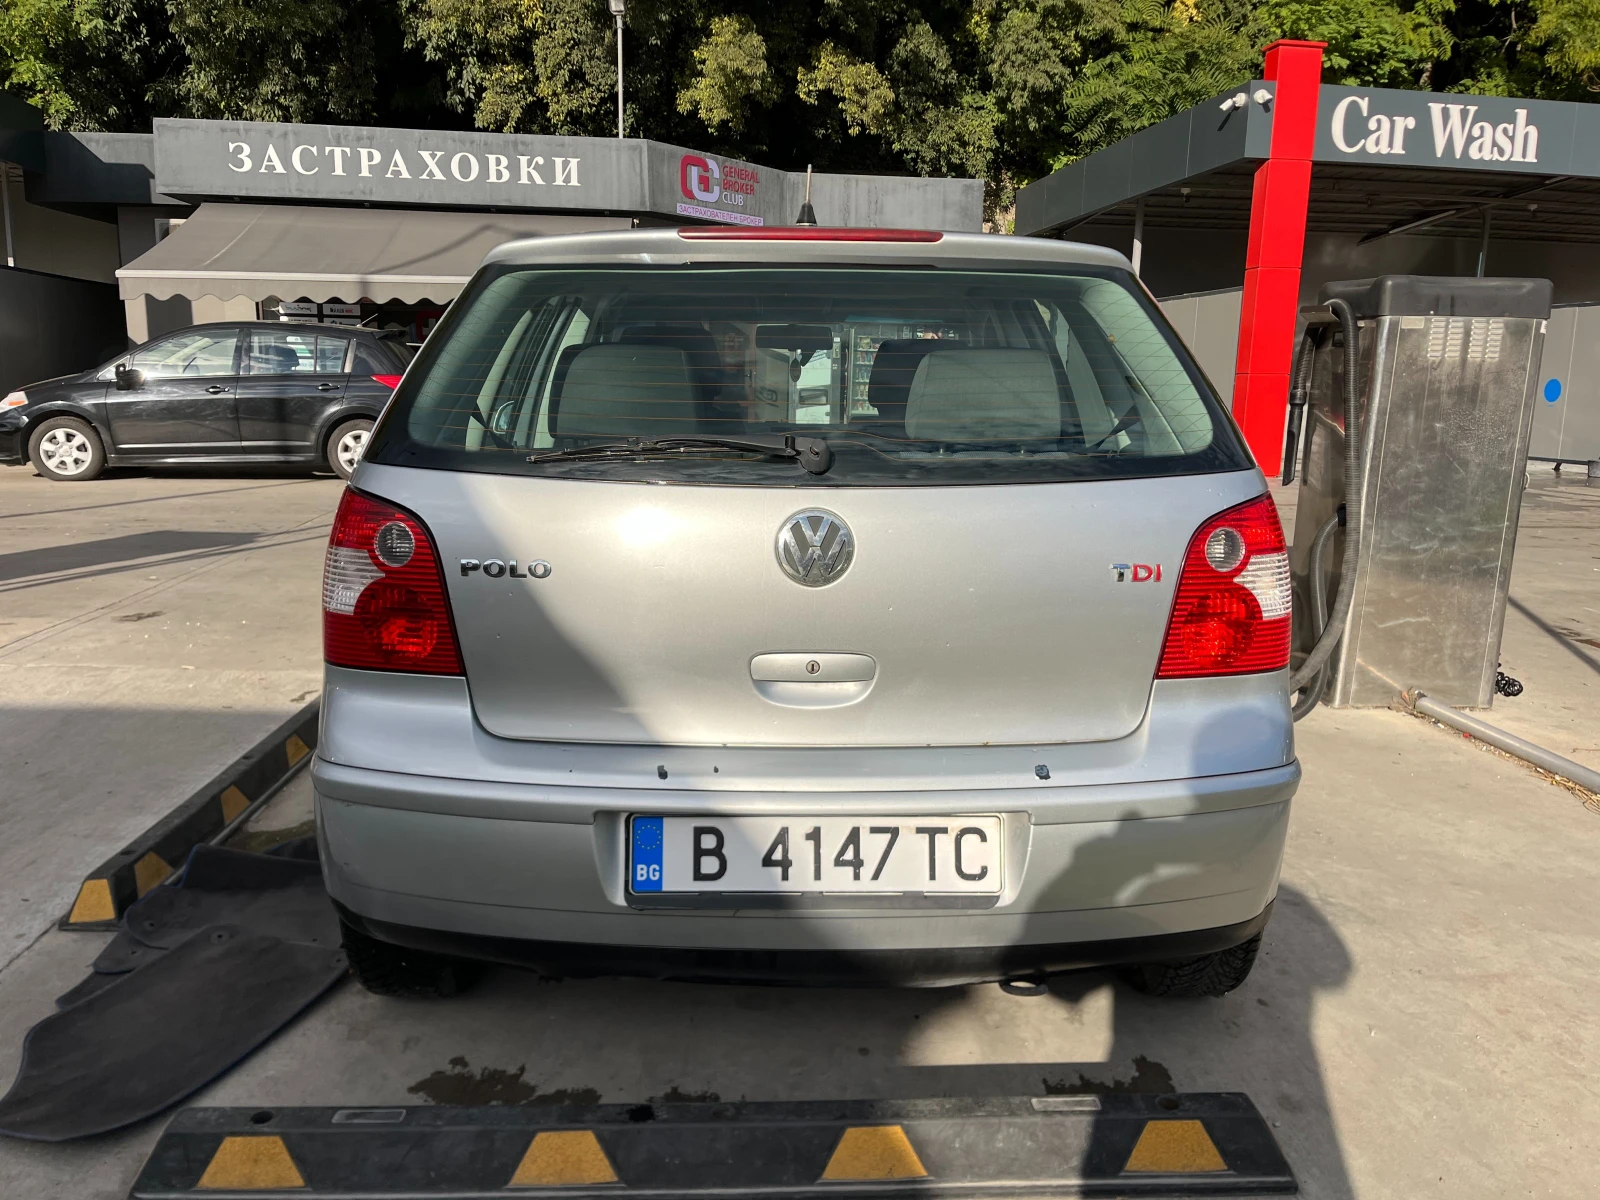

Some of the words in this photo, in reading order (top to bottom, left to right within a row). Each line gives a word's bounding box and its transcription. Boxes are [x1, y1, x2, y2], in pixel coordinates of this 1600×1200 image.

[1331, 95, 1416, 155] Car
[1427, 102, 1539, 163] Wash
[228, 141, 582, 187] ЗАСТРАХОВКИ
[722, 164, 760, 184] GENERAL
[722, 178, 755, 196] BROKER
[722, 191, 744, 206] CLUB
[679, 204, 738, 221] ЗАСТРАХОВАТЕЛЕН
[739, 214, 762, 226] БРОКЕР
[460, 558, 552, 579] POLO
[1109, 563, 1162, 583] TDI
[693, 826, 727, 881] B
[761, 826, 900, 881] 4147
[915, 826, 988, 881] TC
[636, 864, 660, 881] BG
